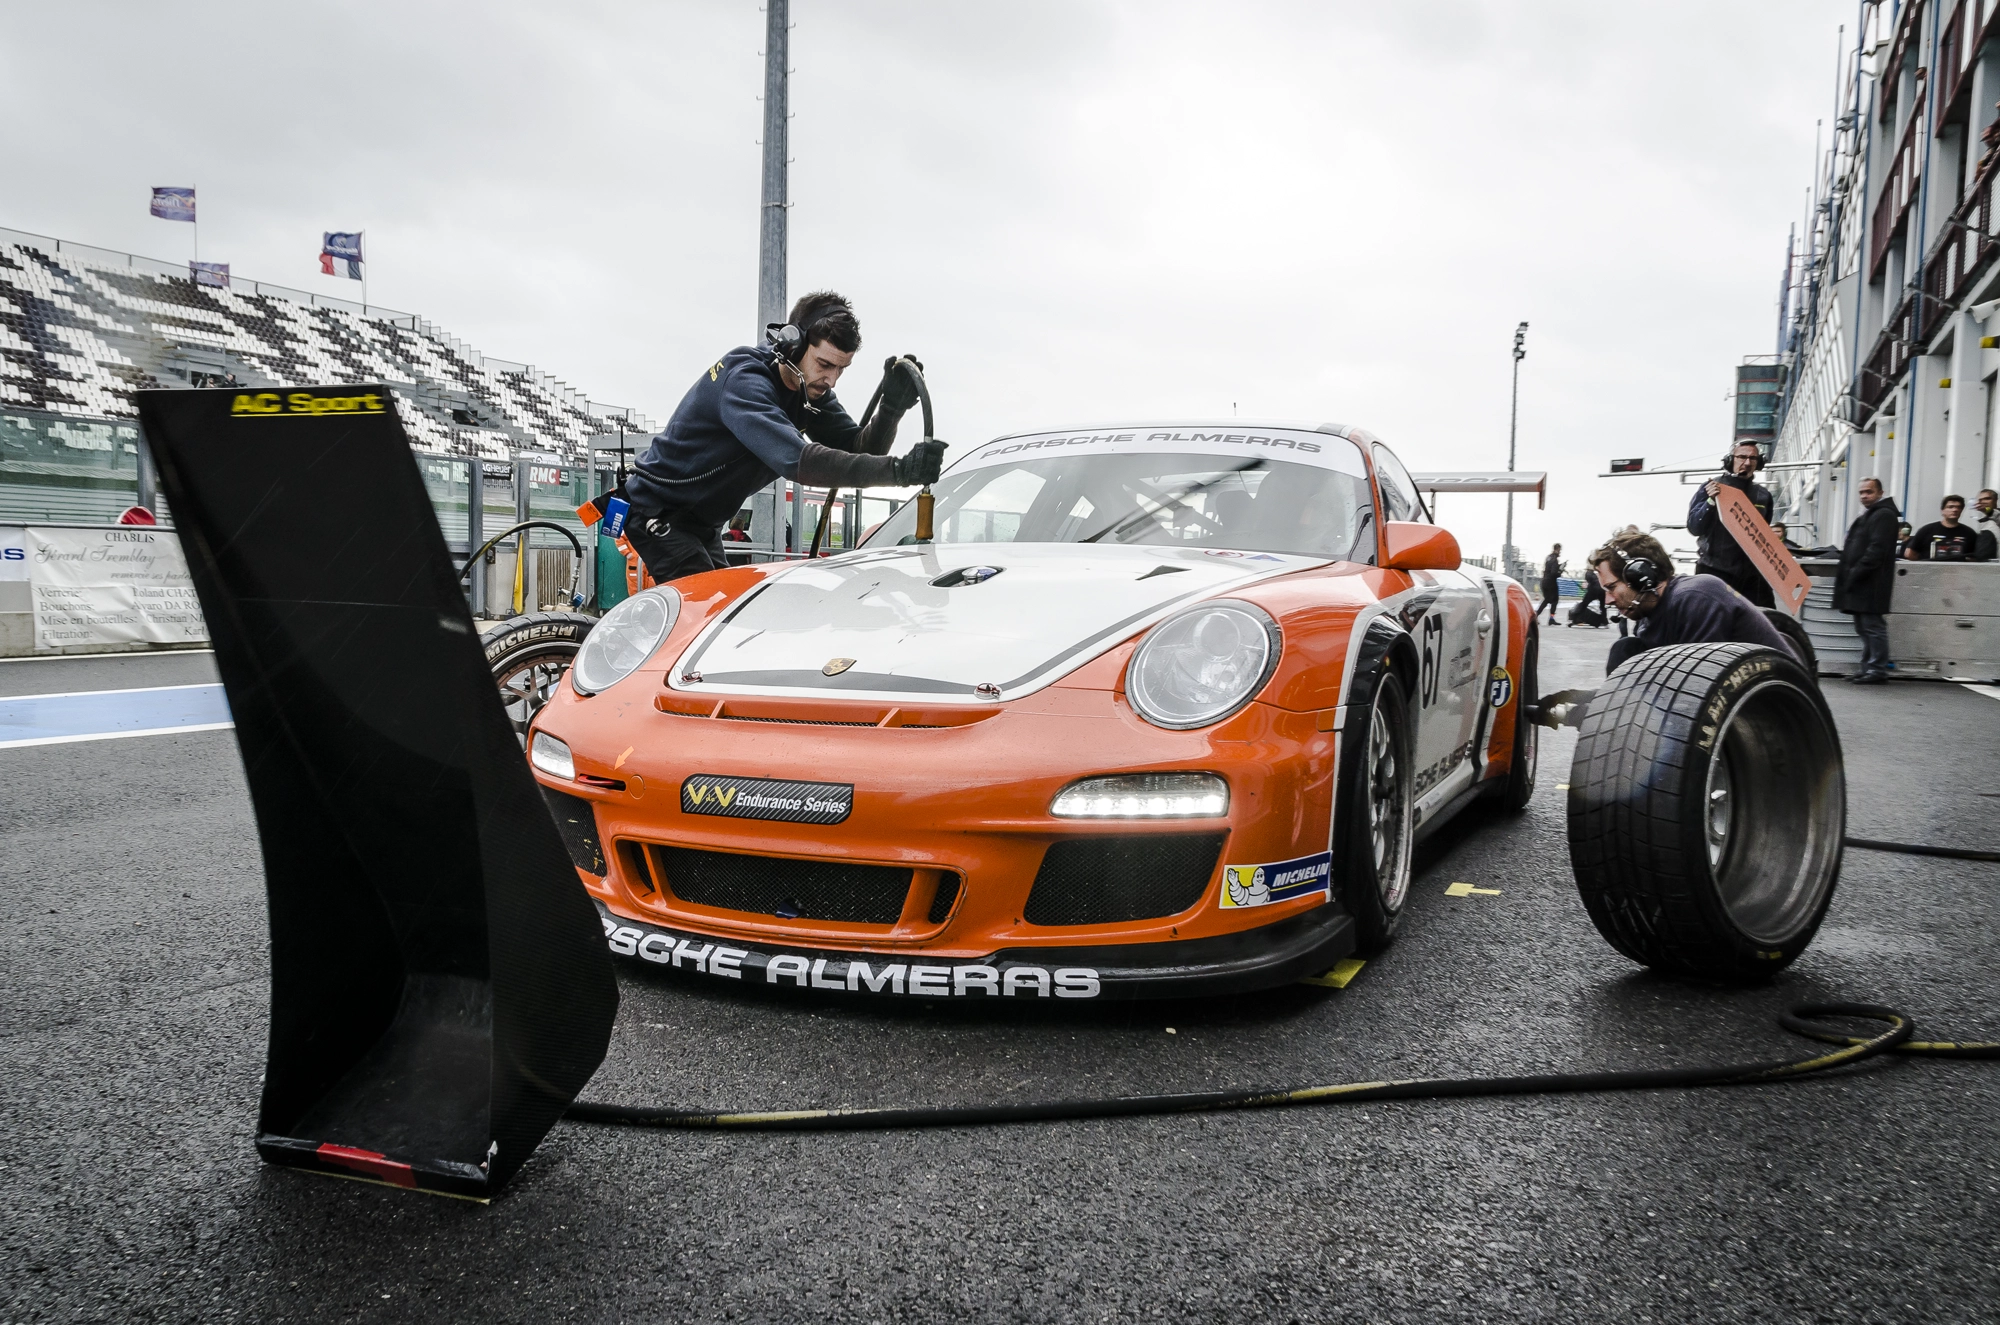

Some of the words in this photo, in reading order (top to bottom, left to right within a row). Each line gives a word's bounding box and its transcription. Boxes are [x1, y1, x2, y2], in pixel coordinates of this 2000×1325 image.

[231, 393, 282, 412] AC
[287, 393, 385, 416] Sport
[980, 433, 1136, 460] PORSCHE
[1146, 433, 1322, 453] ALMERAS
[529, 466, 557, 483] RMC
[105, 532, 155, 543] CHABLIS
[1729, 507, 1786, 581] ALMERAS
[1733, 501, 1790, 576] PORSCHE
[35, 542, 87, 563] Gérard
[90, 545, 156, 568] Tremblay
[38, 587, 82, 598] Verrerie:
[40, 602, 95, 612] Bouchons:
[41, 616, 67, 626] Mise
[70, 617, 83, 625] en
[86, 614, 138, 625] bouteilles:
[42, 629, 93, 640] Filtration:
[485, 625, 575, 660] MICHELIN
[1422, 613, 1442, 710] 67
[1490, 680, 1509, 706] FJ
[735, 792, 801, 811] Endurance
[803, 797, 847, 814] Series
[1272, 862, 1331, 888] MICHELIN
[766, 954, 1100, 998] ALMERAS
